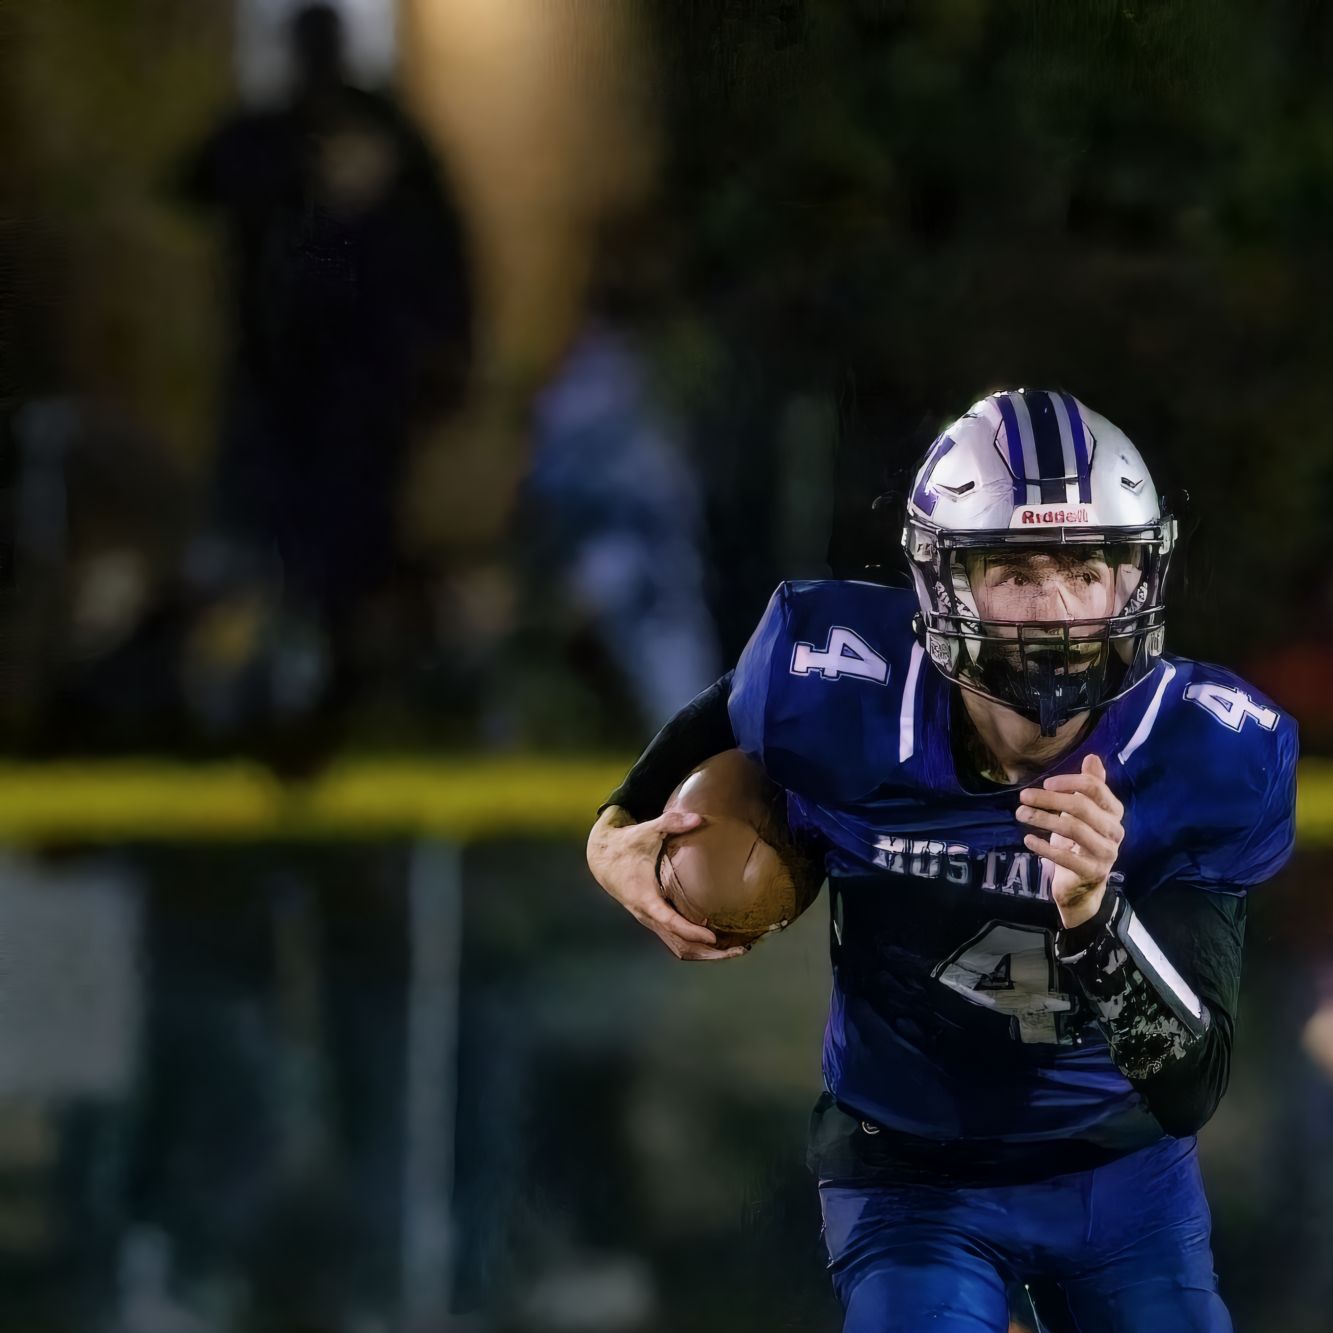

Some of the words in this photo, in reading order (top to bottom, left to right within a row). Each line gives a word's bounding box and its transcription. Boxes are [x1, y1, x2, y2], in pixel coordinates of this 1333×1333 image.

[791, 624, 893, 687] 4
[1183, 680, 1282, 733] 4
[930, 918, 1080, 1046] 4
